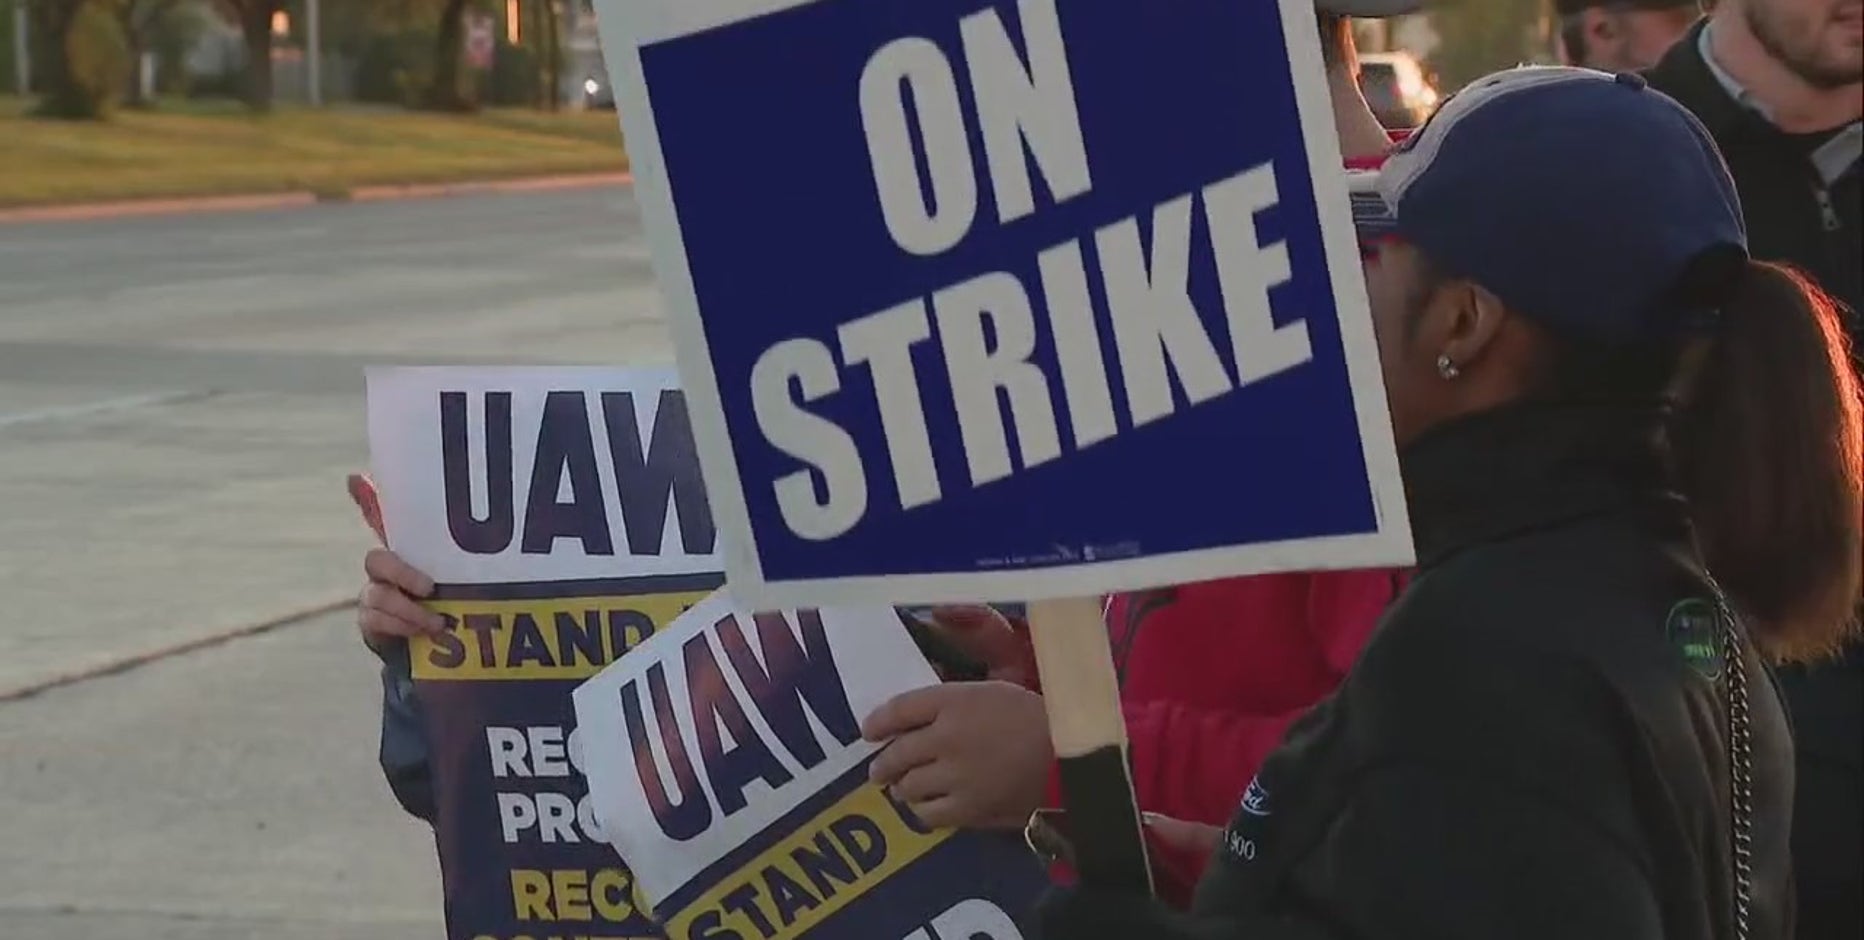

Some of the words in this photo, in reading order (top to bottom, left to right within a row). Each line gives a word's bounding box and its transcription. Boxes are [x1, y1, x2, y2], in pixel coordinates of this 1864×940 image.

[858, 0, 1092, 257] ON
[749, 160, 1314, 541] STRIKE
[440, 389, 717, 555] UAW
[428, 610, 655, 669] STAND
[620, 608, 863, 842] UAW
[688, 813, 889, 940] STAND
